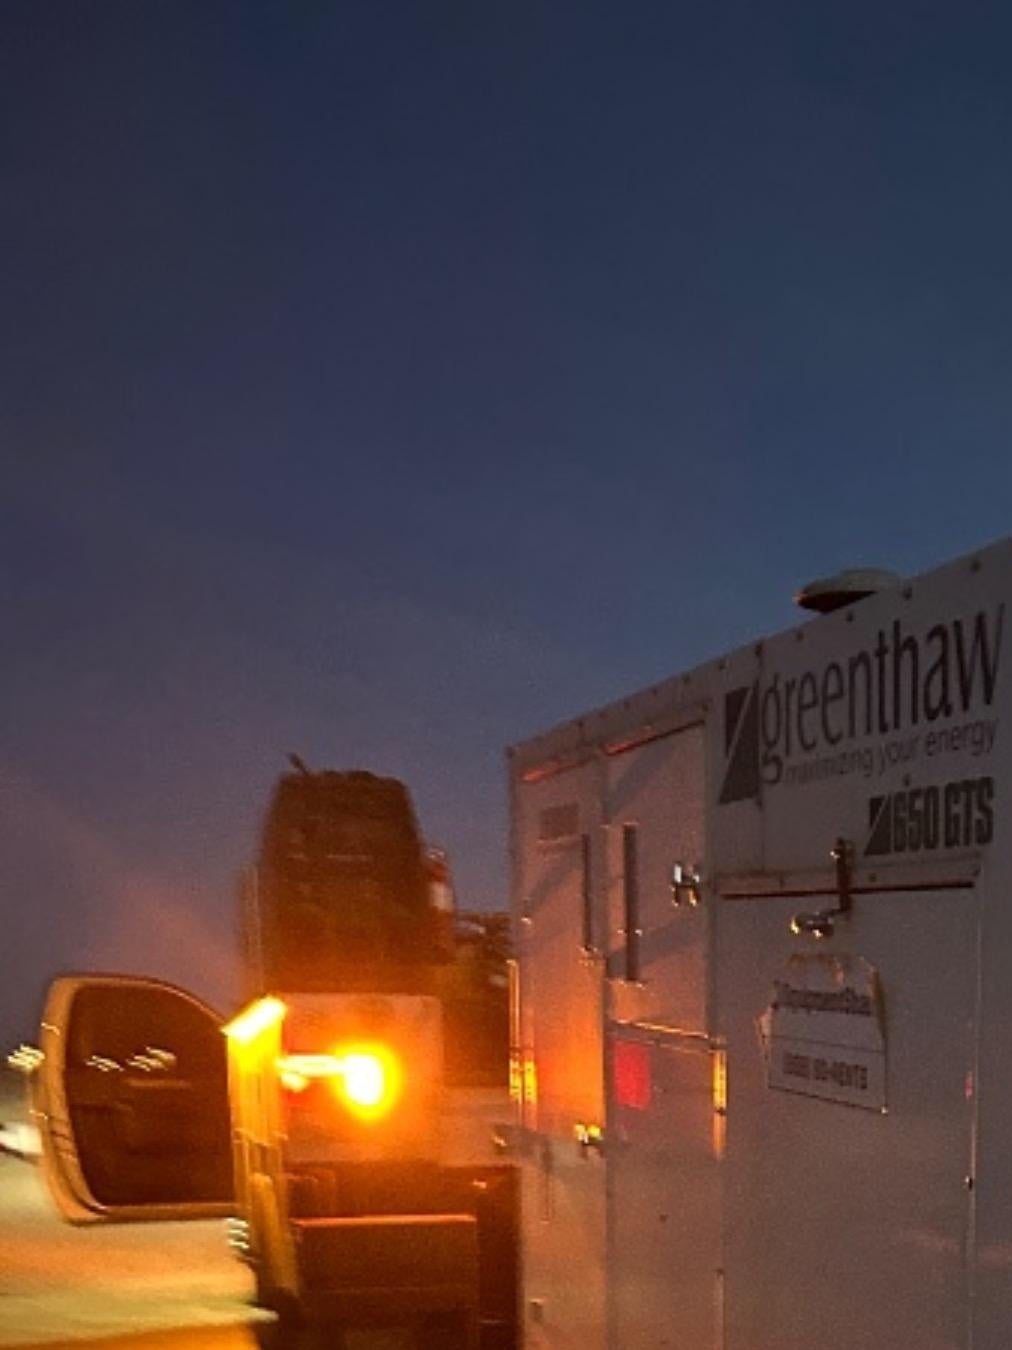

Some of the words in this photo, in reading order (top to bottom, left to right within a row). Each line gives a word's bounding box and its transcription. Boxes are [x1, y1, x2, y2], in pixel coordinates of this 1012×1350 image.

[760, 602, 1004, 785] greenthaw
[925, 717, 999, 757] energy
[944, 776, 994, 849] GTS
